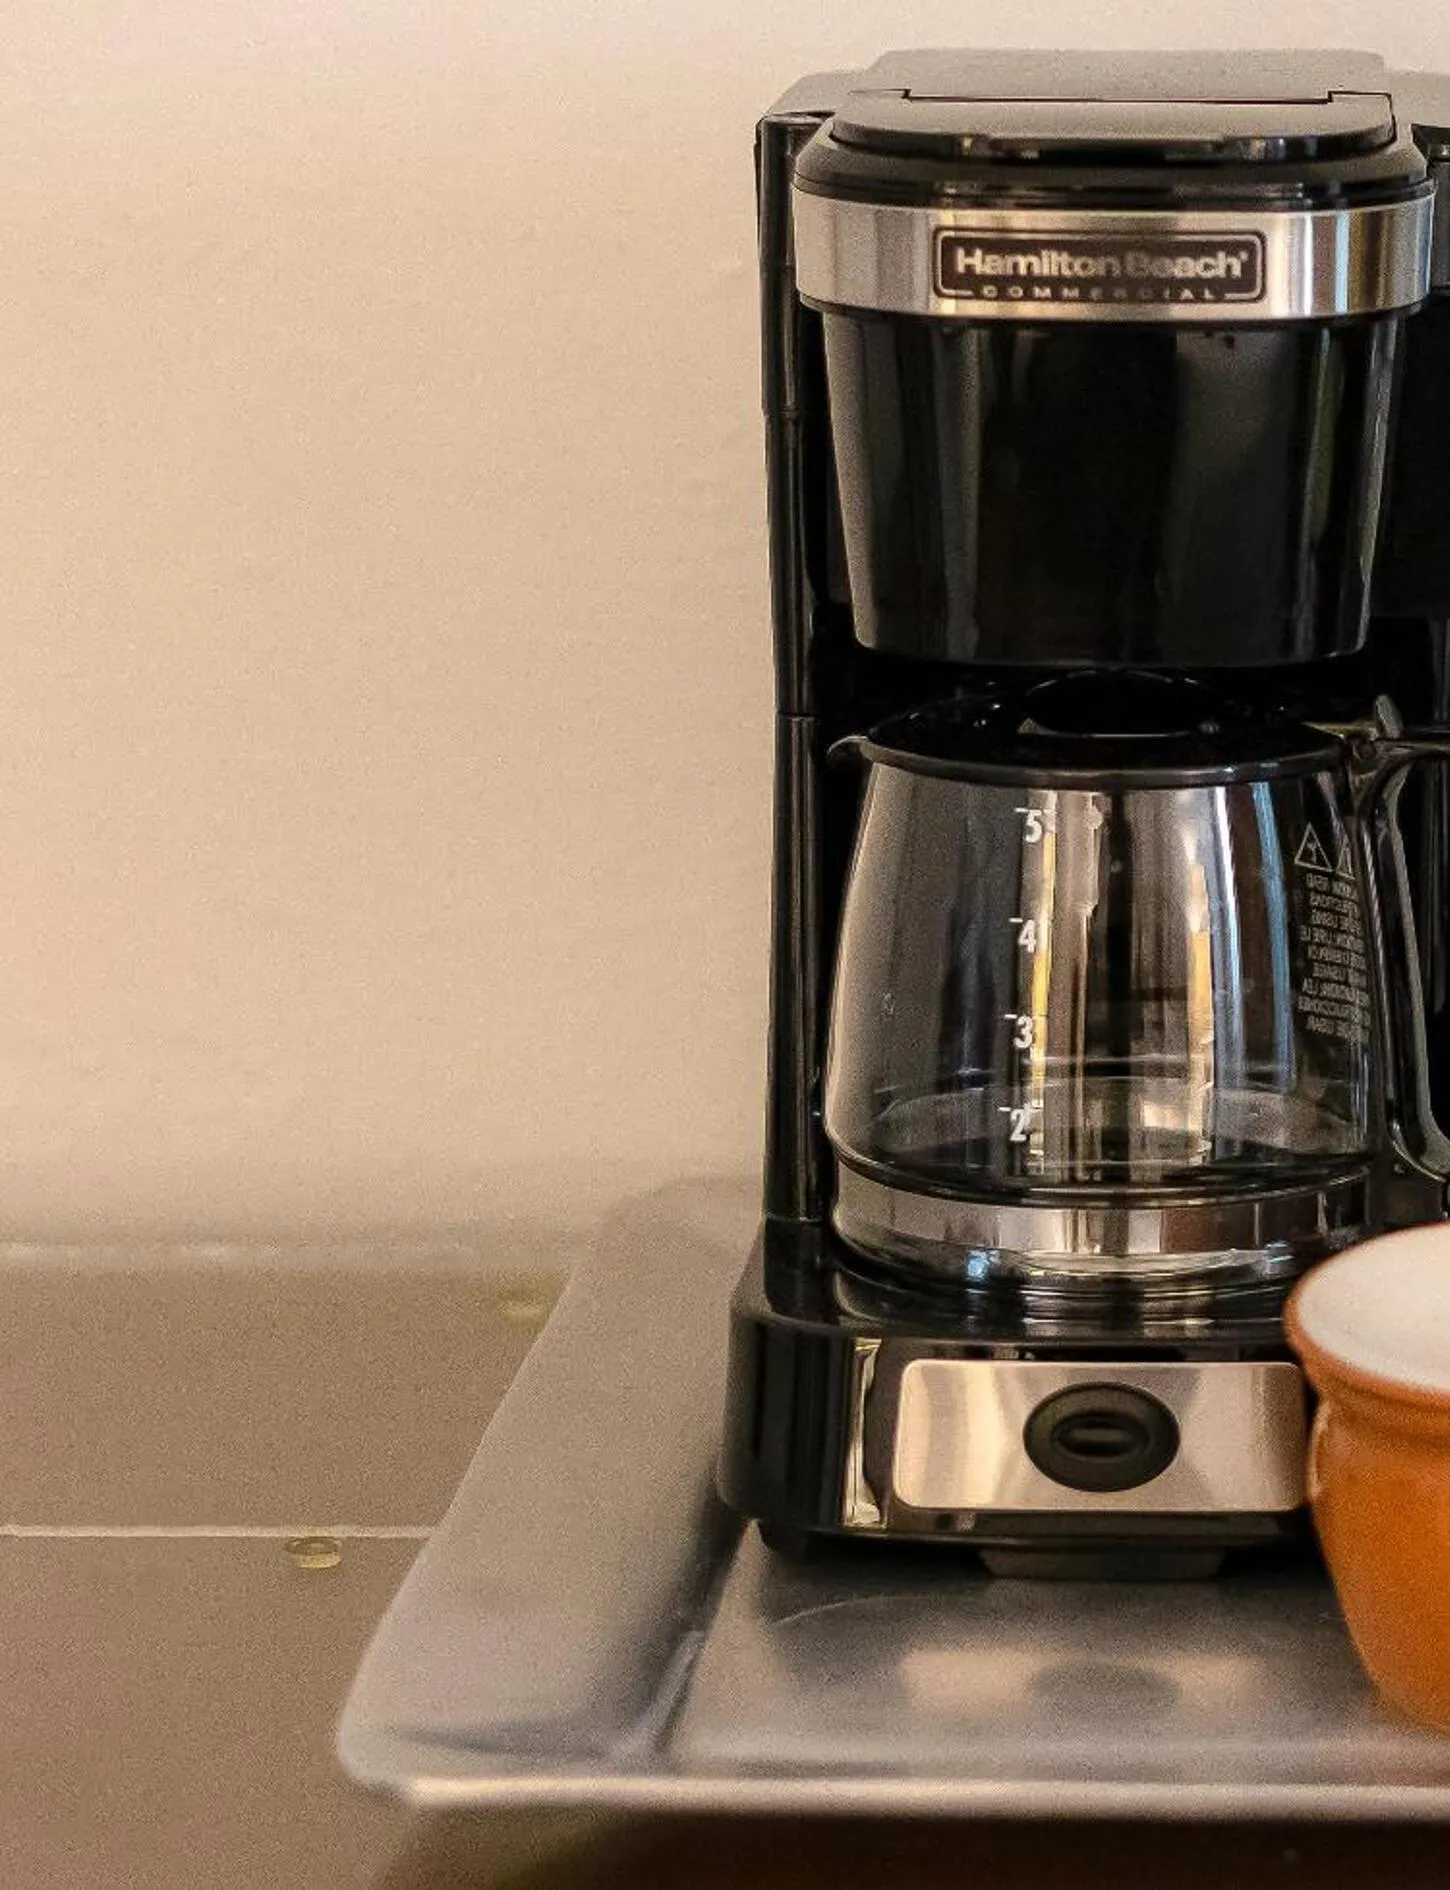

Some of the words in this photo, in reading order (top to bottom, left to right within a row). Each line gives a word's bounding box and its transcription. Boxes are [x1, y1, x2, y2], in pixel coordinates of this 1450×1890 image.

[956, 247, 1121, 278] Hamilton
[1126, 251, 1242, 280] Beach
[981, 284, 1216, 301] COMMERCIAL
[1025, 809, 1043, 844] 5
[1018, 919, 1036, 953] 4
[1014, 1015, 1033, 1049] 3
[1010, 1104, 1030, 1142] 2
